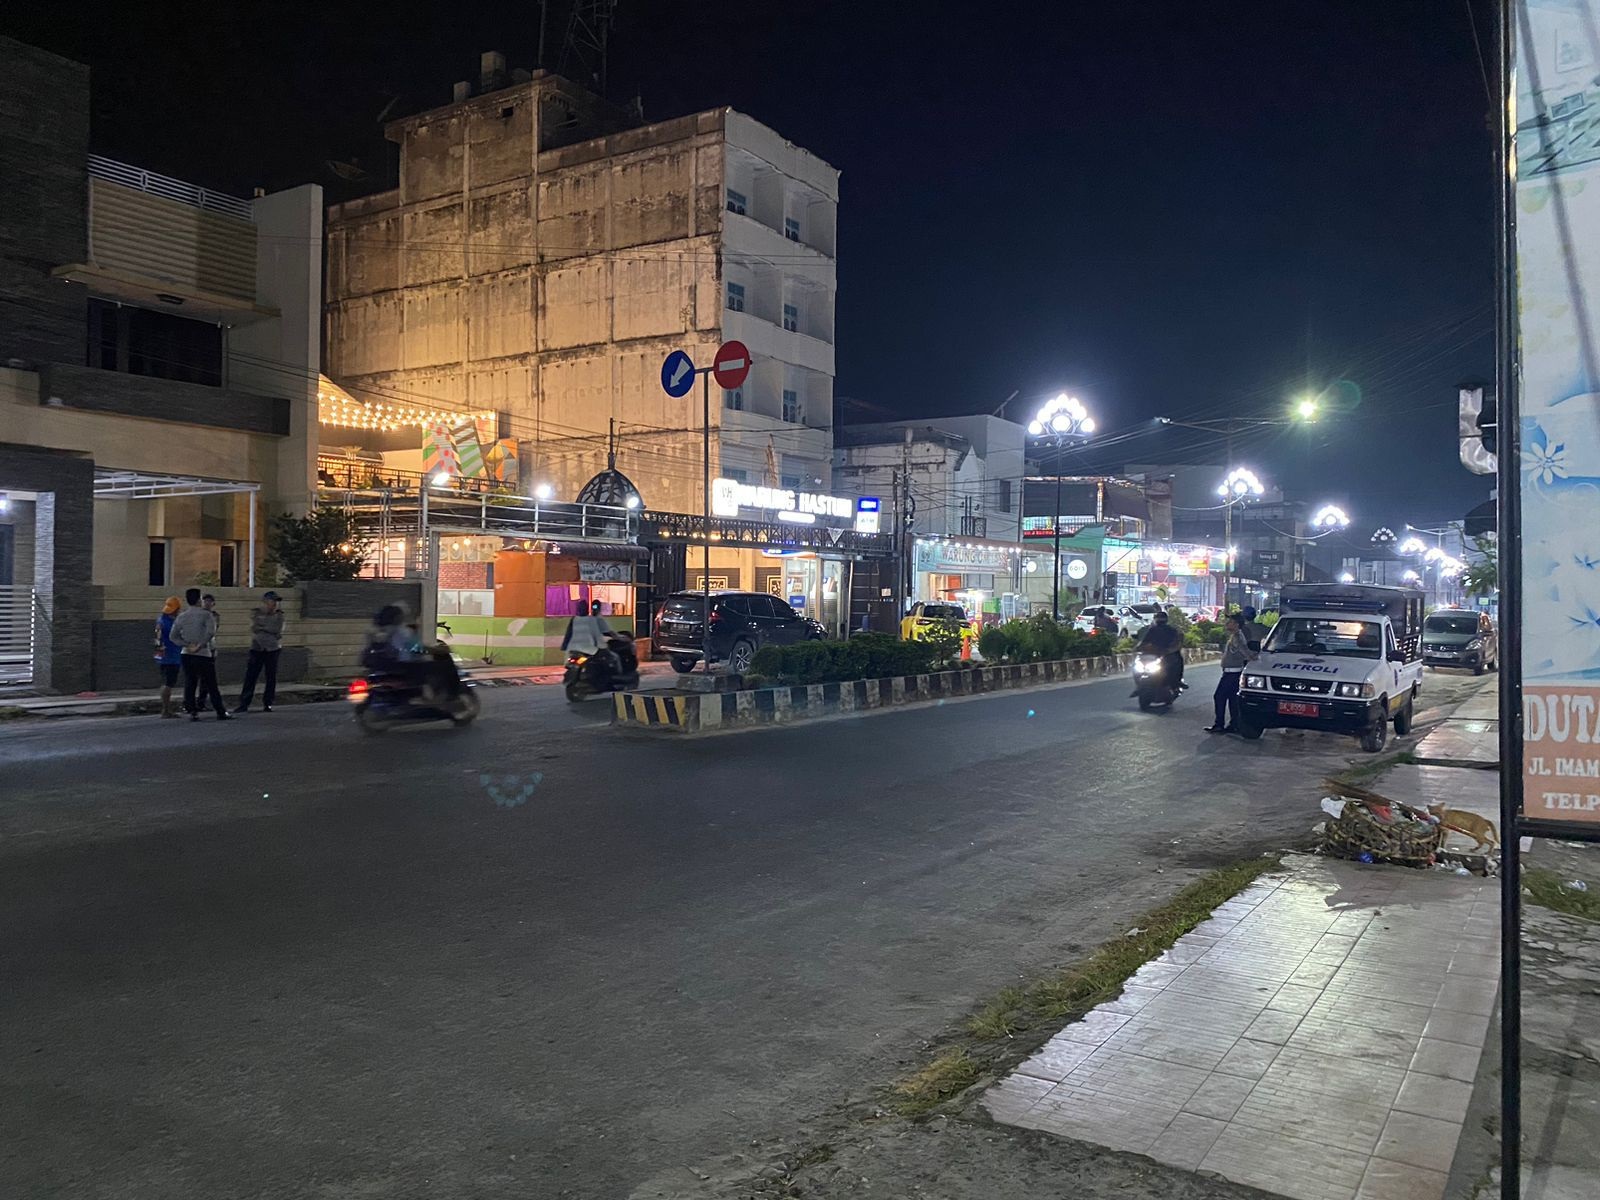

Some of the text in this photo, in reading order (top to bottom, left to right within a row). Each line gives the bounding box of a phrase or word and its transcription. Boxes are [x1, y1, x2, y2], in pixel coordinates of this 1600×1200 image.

[1269, 663, 1339, 674] PATROLI
[1528, 757, 1600, 777] JL. IMAM
[1542, 792, 1600, 811] TELP
